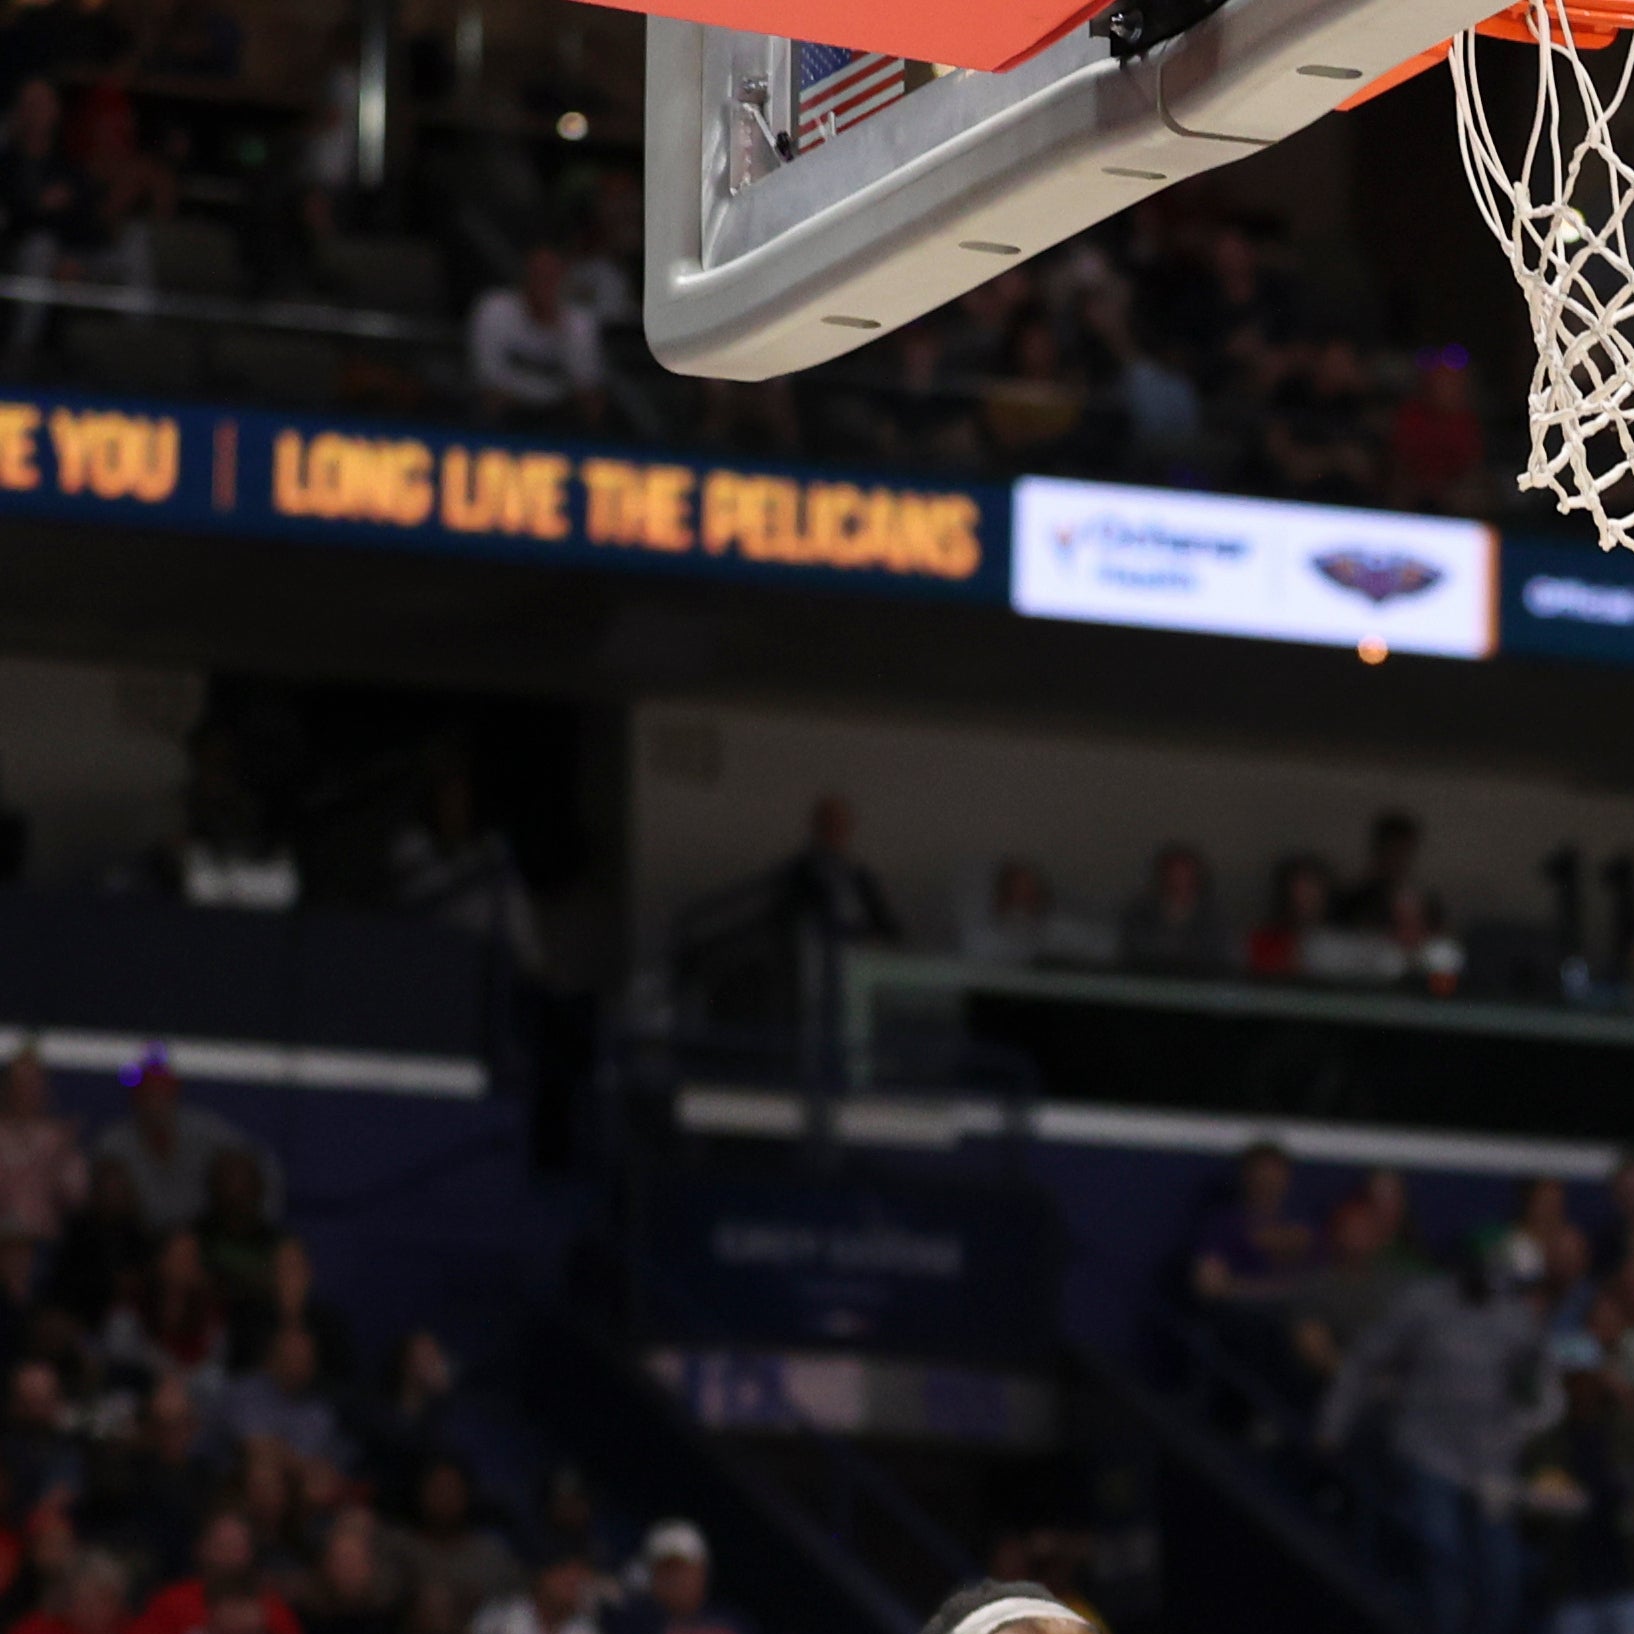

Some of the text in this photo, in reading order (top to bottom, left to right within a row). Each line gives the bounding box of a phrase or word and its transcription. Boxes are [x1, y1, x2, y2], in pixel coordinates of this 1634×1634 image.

[49, 407, 181, 502] YOU
[273, 428, 433, 528] LONG
[440, 445, 573, 541] LIVE
[581, 457, 695, 553] THE
[702, 469, 983, 581] PELICANS
